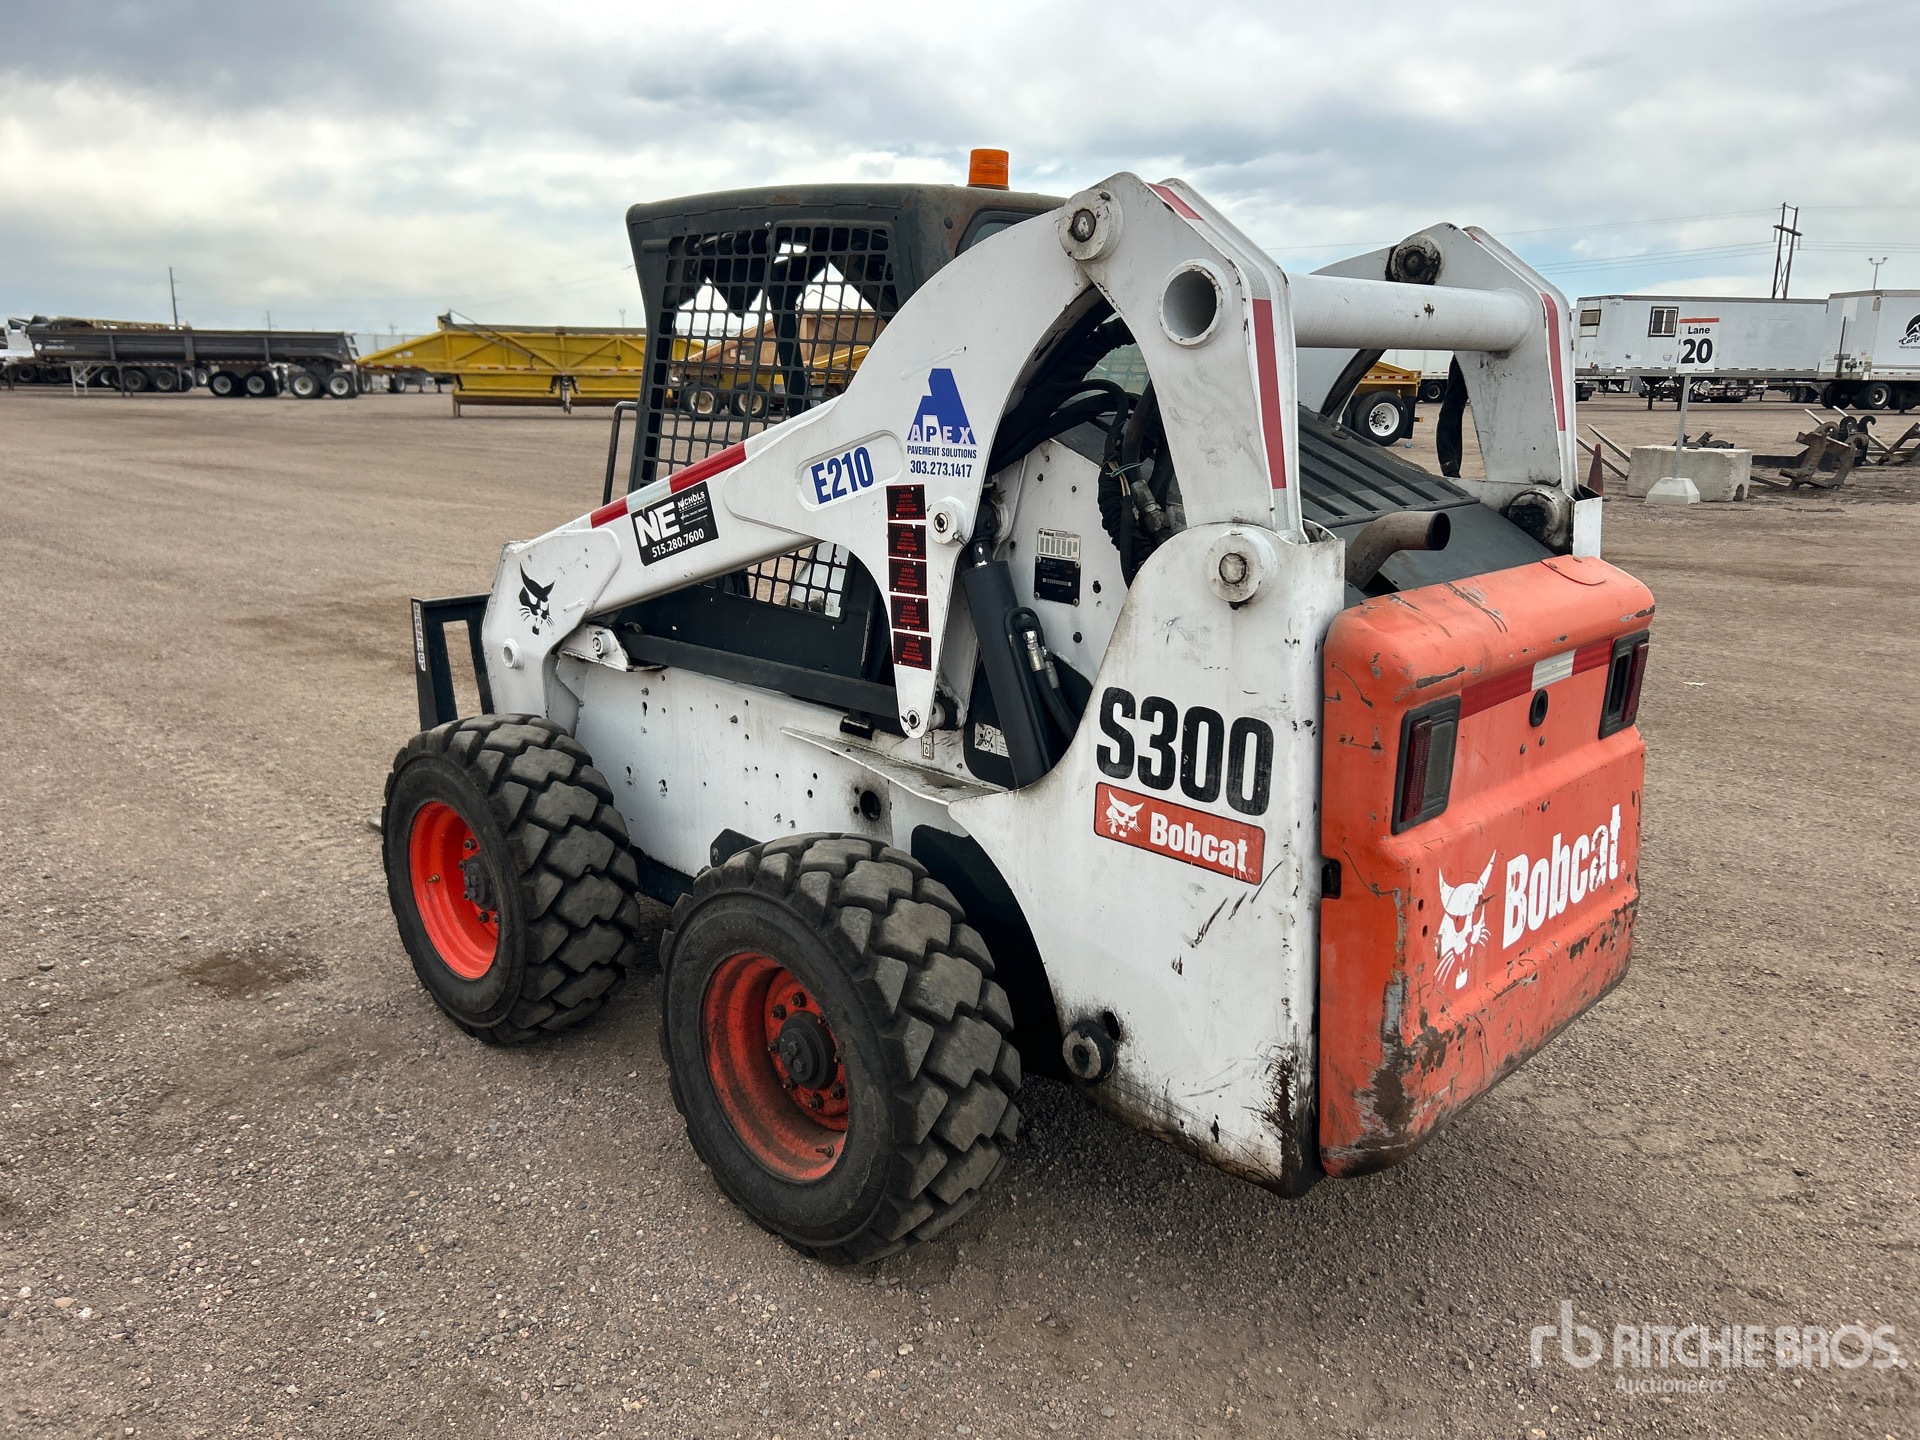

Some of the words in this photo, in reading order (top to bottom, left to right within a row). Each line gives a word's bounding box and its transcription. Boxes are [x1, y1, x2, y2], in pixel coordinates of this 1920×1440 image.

[1687, 326, 1711, 335] Lane
[1680, 338, 1713, 364] 20
[909, 424, 972, 444] APEX
[906, 445, 940, 457] PAVEMENT
[941, 447, 977, 459] SOLUTIONS
[811, 446, 875, 504] E210
[910, 460, 973, 478] 303.273.1417
[635, 501, 680, 547] NE
[651, 528, 705, 558] 515.280.7600
[1096, 687, 1274, 816] S300
[1150, 811, 1248, 872] Bobcat
[1503, 803, 1621, 949] Bobcat
